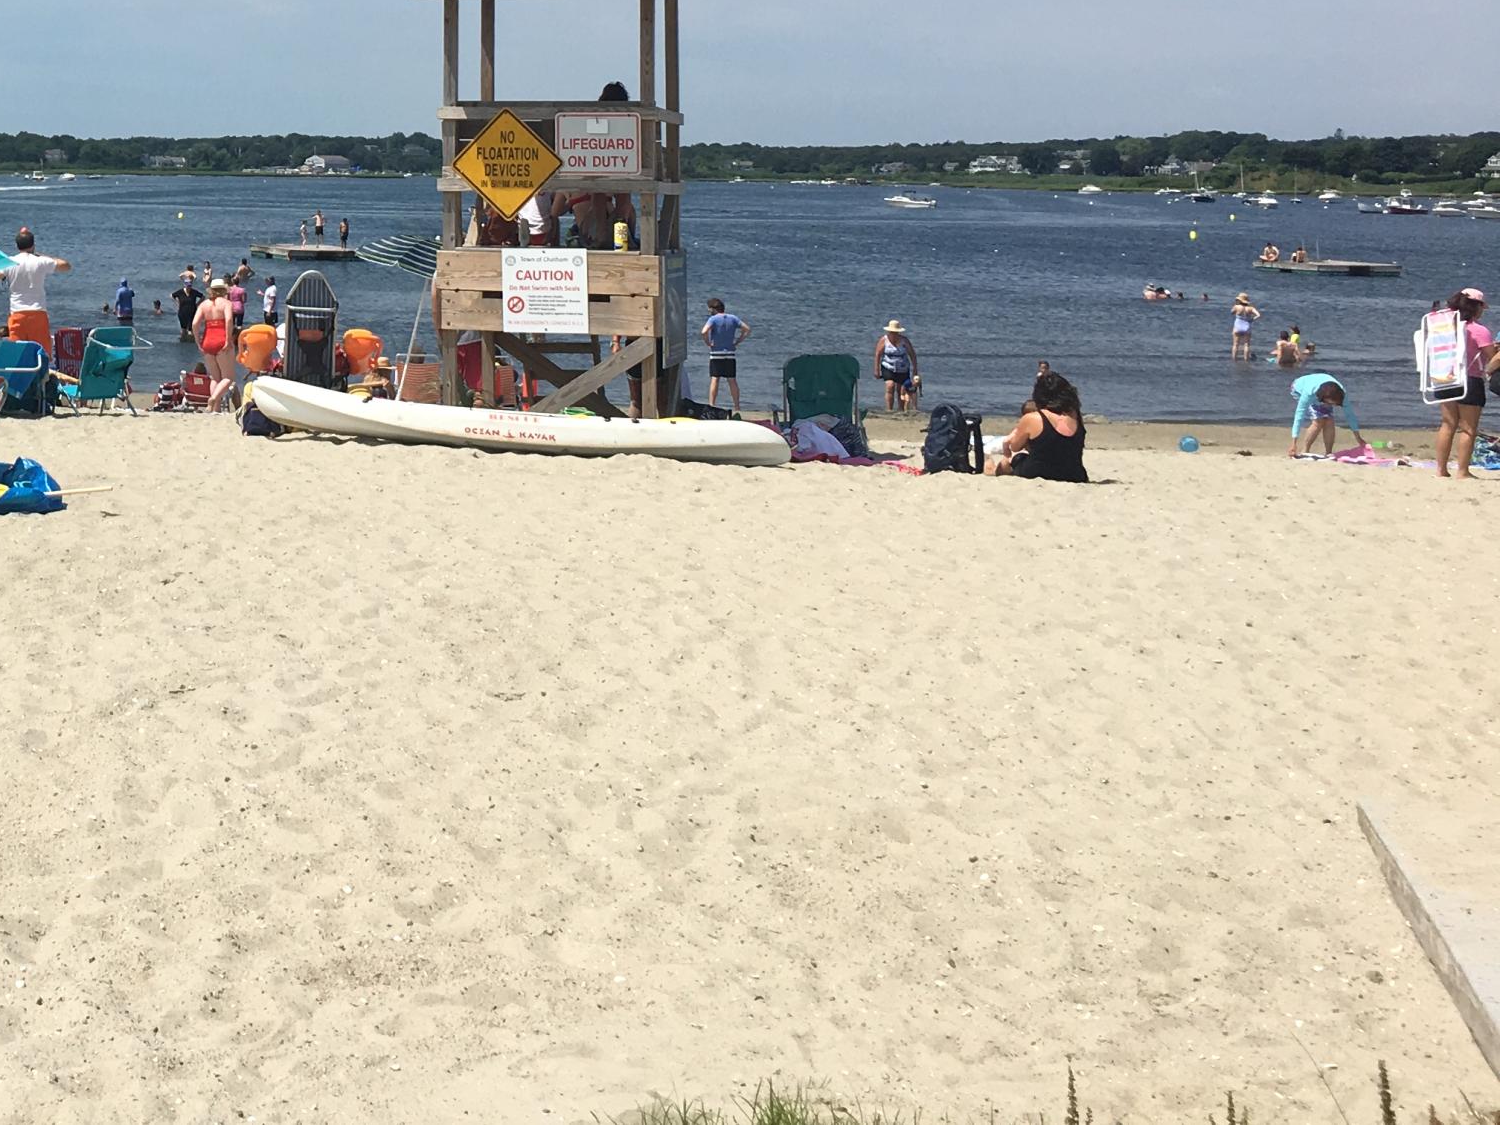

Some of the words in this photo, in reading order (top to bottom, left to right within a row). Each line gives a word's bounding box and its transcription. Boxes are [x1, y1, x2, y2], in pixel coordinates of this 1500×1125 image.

[500, 130, 515, 144] NO
[562, 138, 634, 150] LIFEGUARD
[476, 147, 539, 160] FLOATATION
[568, 156, 586, 168] ON
[592, 156, 628, 168] DUTY
[484, 164, 530, 177] DEVICES
[480, 180, 488, 188] IN
[514, 180, 534, 188] AREA
[516, 270, 574, 281] CAUTION
[464, 426, 500, 436] OCEAN
[519, 432, 556, 442] KAYAK
